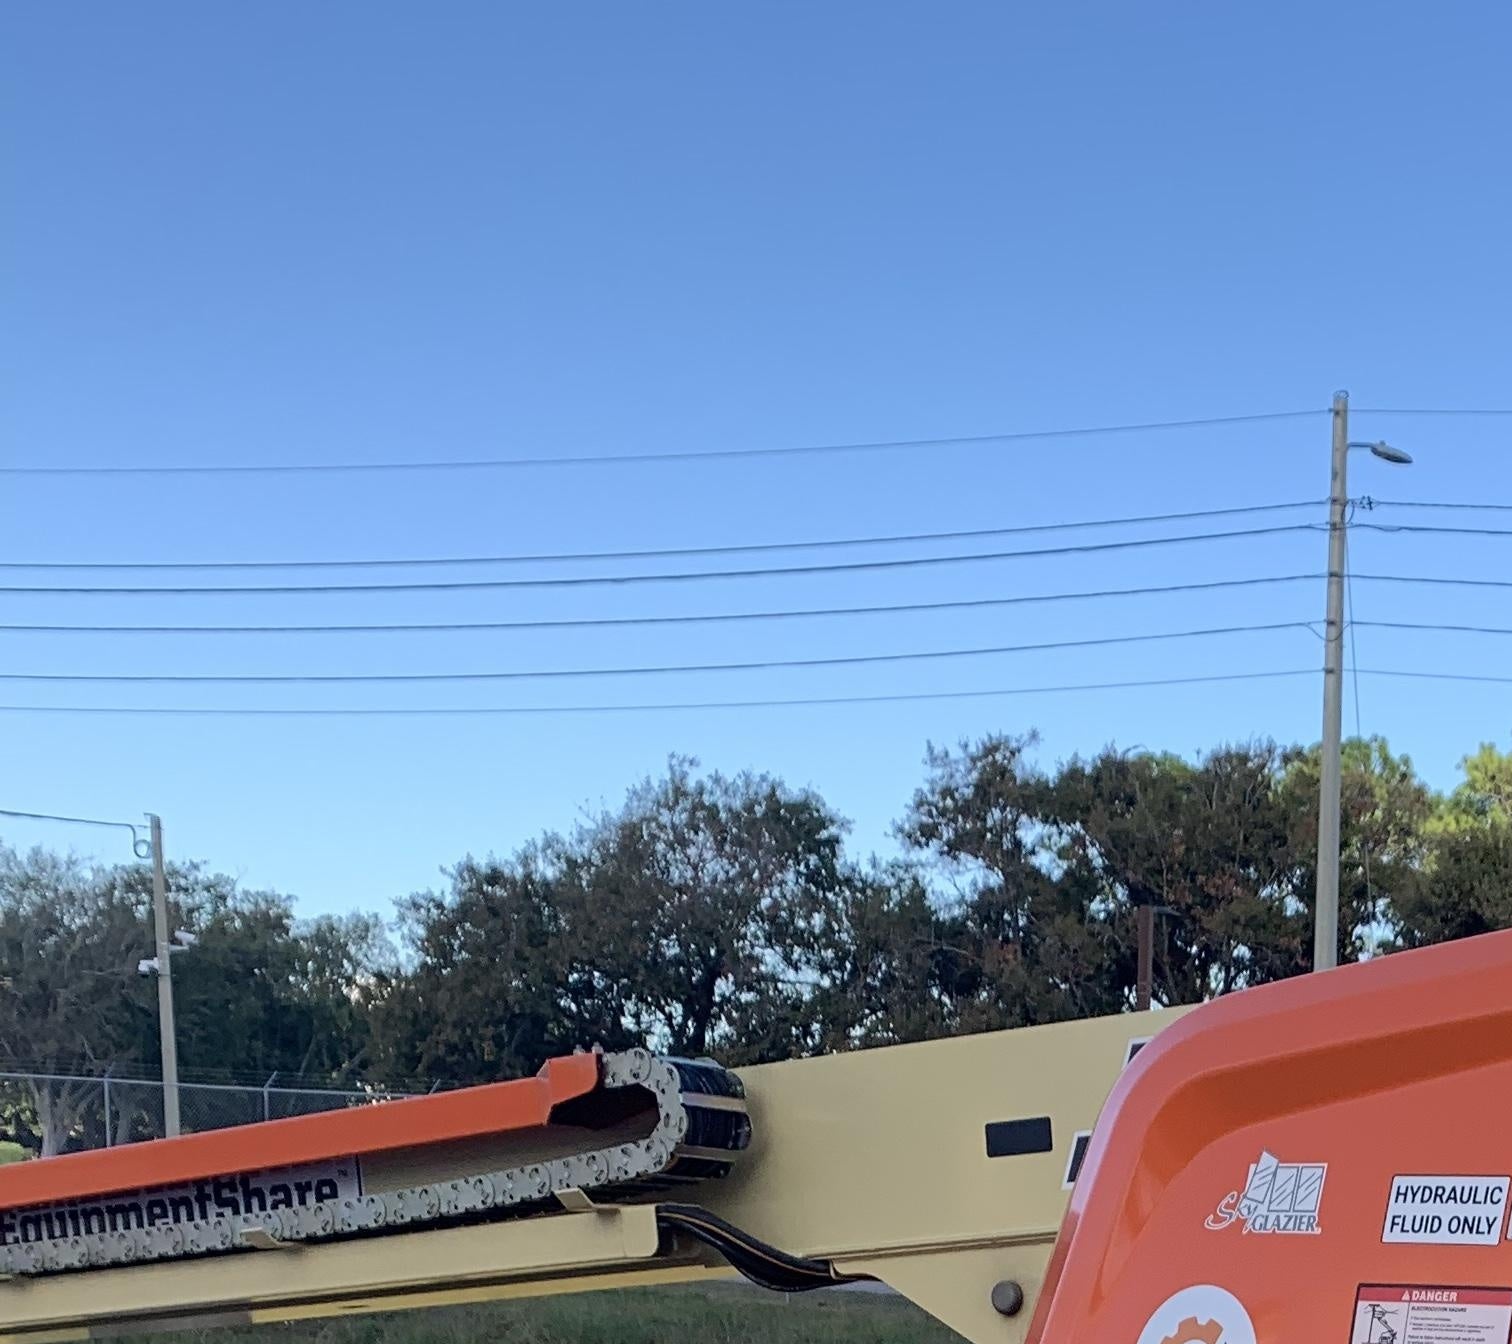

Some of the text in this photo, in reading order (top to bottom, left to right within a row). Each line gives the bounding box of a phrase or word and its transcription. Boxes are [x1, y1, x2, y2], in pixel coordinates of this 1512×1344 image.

[1394, 1184, 1503, 1206] HYDRAULIC
[1253, 1213, 1316, 1232] GLAZIER
[1389, 1214, 1498, 1236] FLUID ONLY
[1411, 1289, 1458, 1302] DANGER
